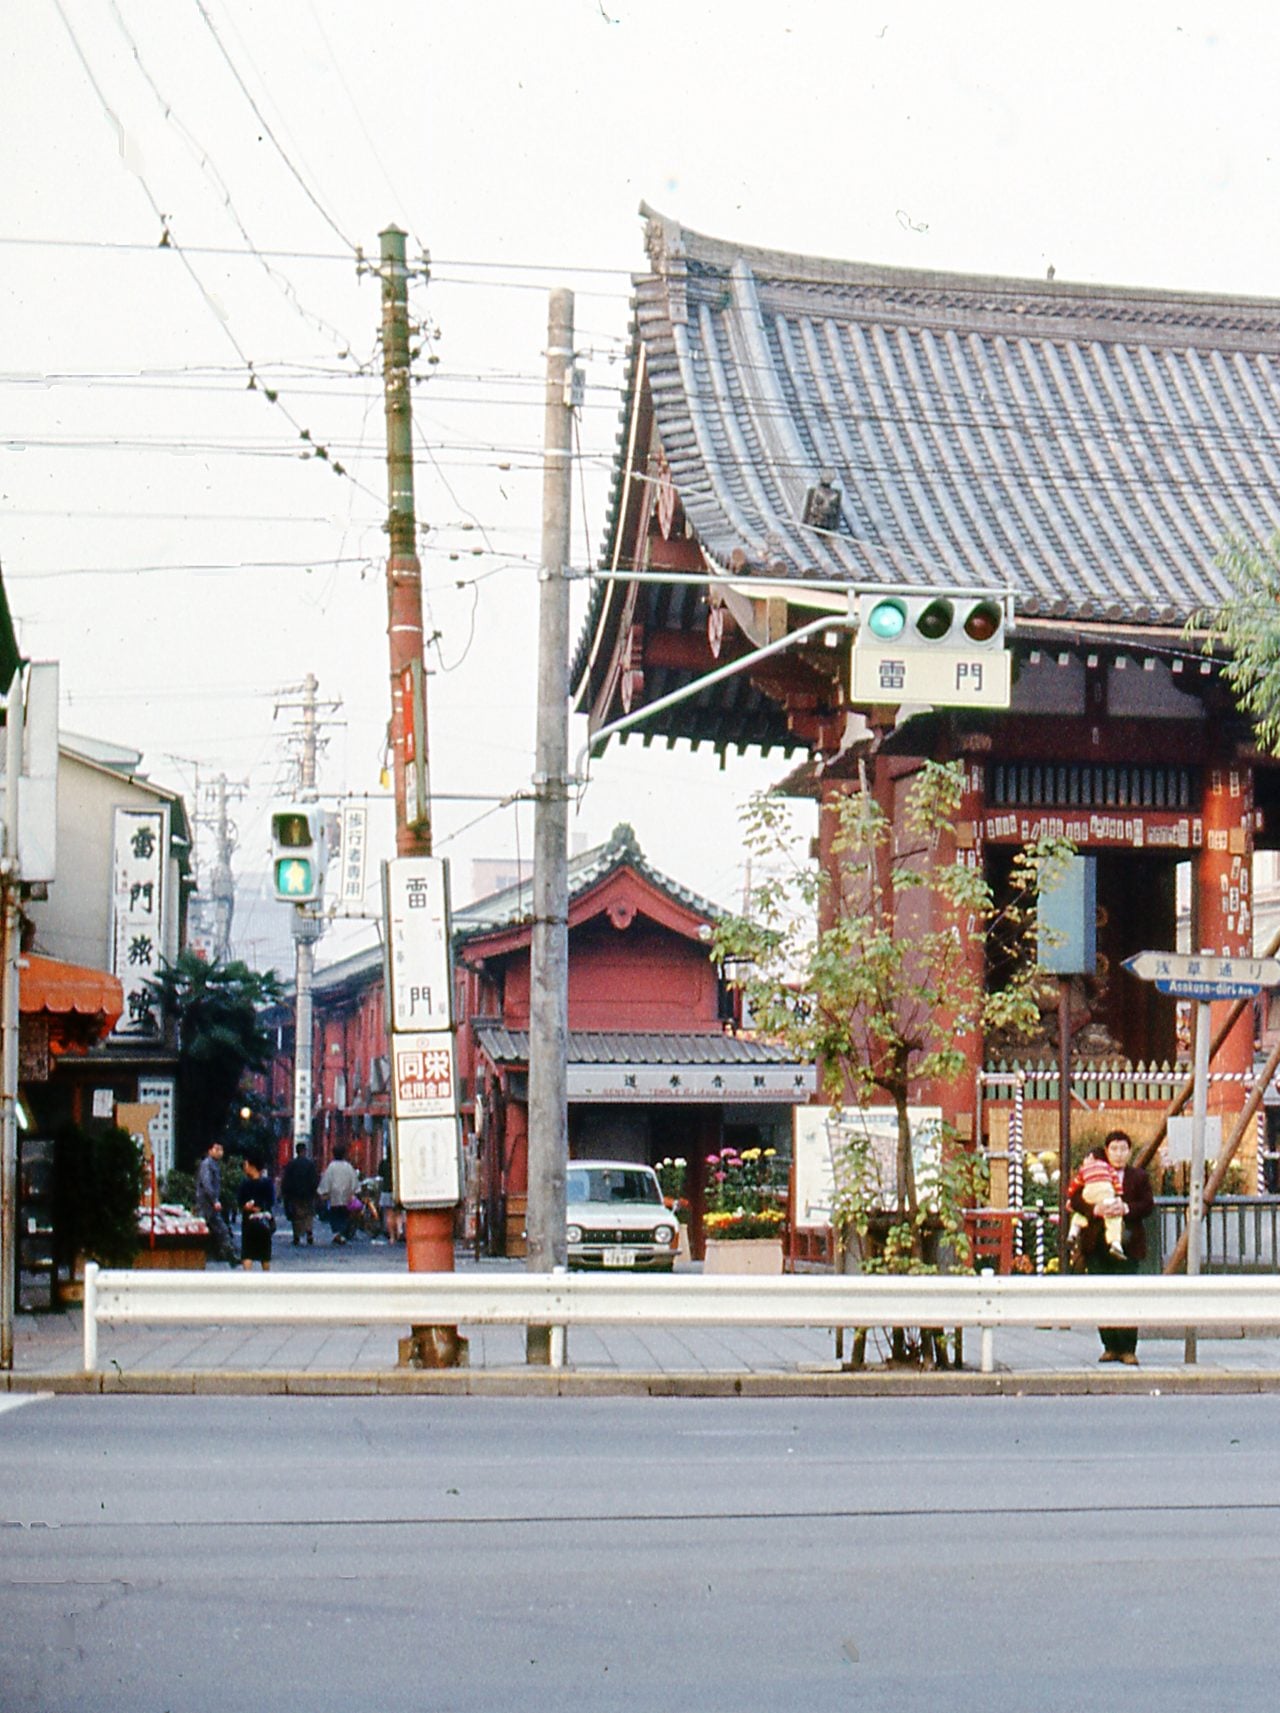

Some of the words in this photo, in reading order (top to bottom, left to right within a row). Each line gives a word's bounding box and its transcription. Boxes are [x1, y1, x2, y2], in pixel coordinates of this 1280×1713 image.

[879, 659, 983, 691] 雷門
[406, 877, 432, 1017] 雷門
[1156, 960, 1262, 979] 浅草通り
[399, 1052, 449, 1081] 同栄
[400, 1081, 450, 1099] 信用金庫
